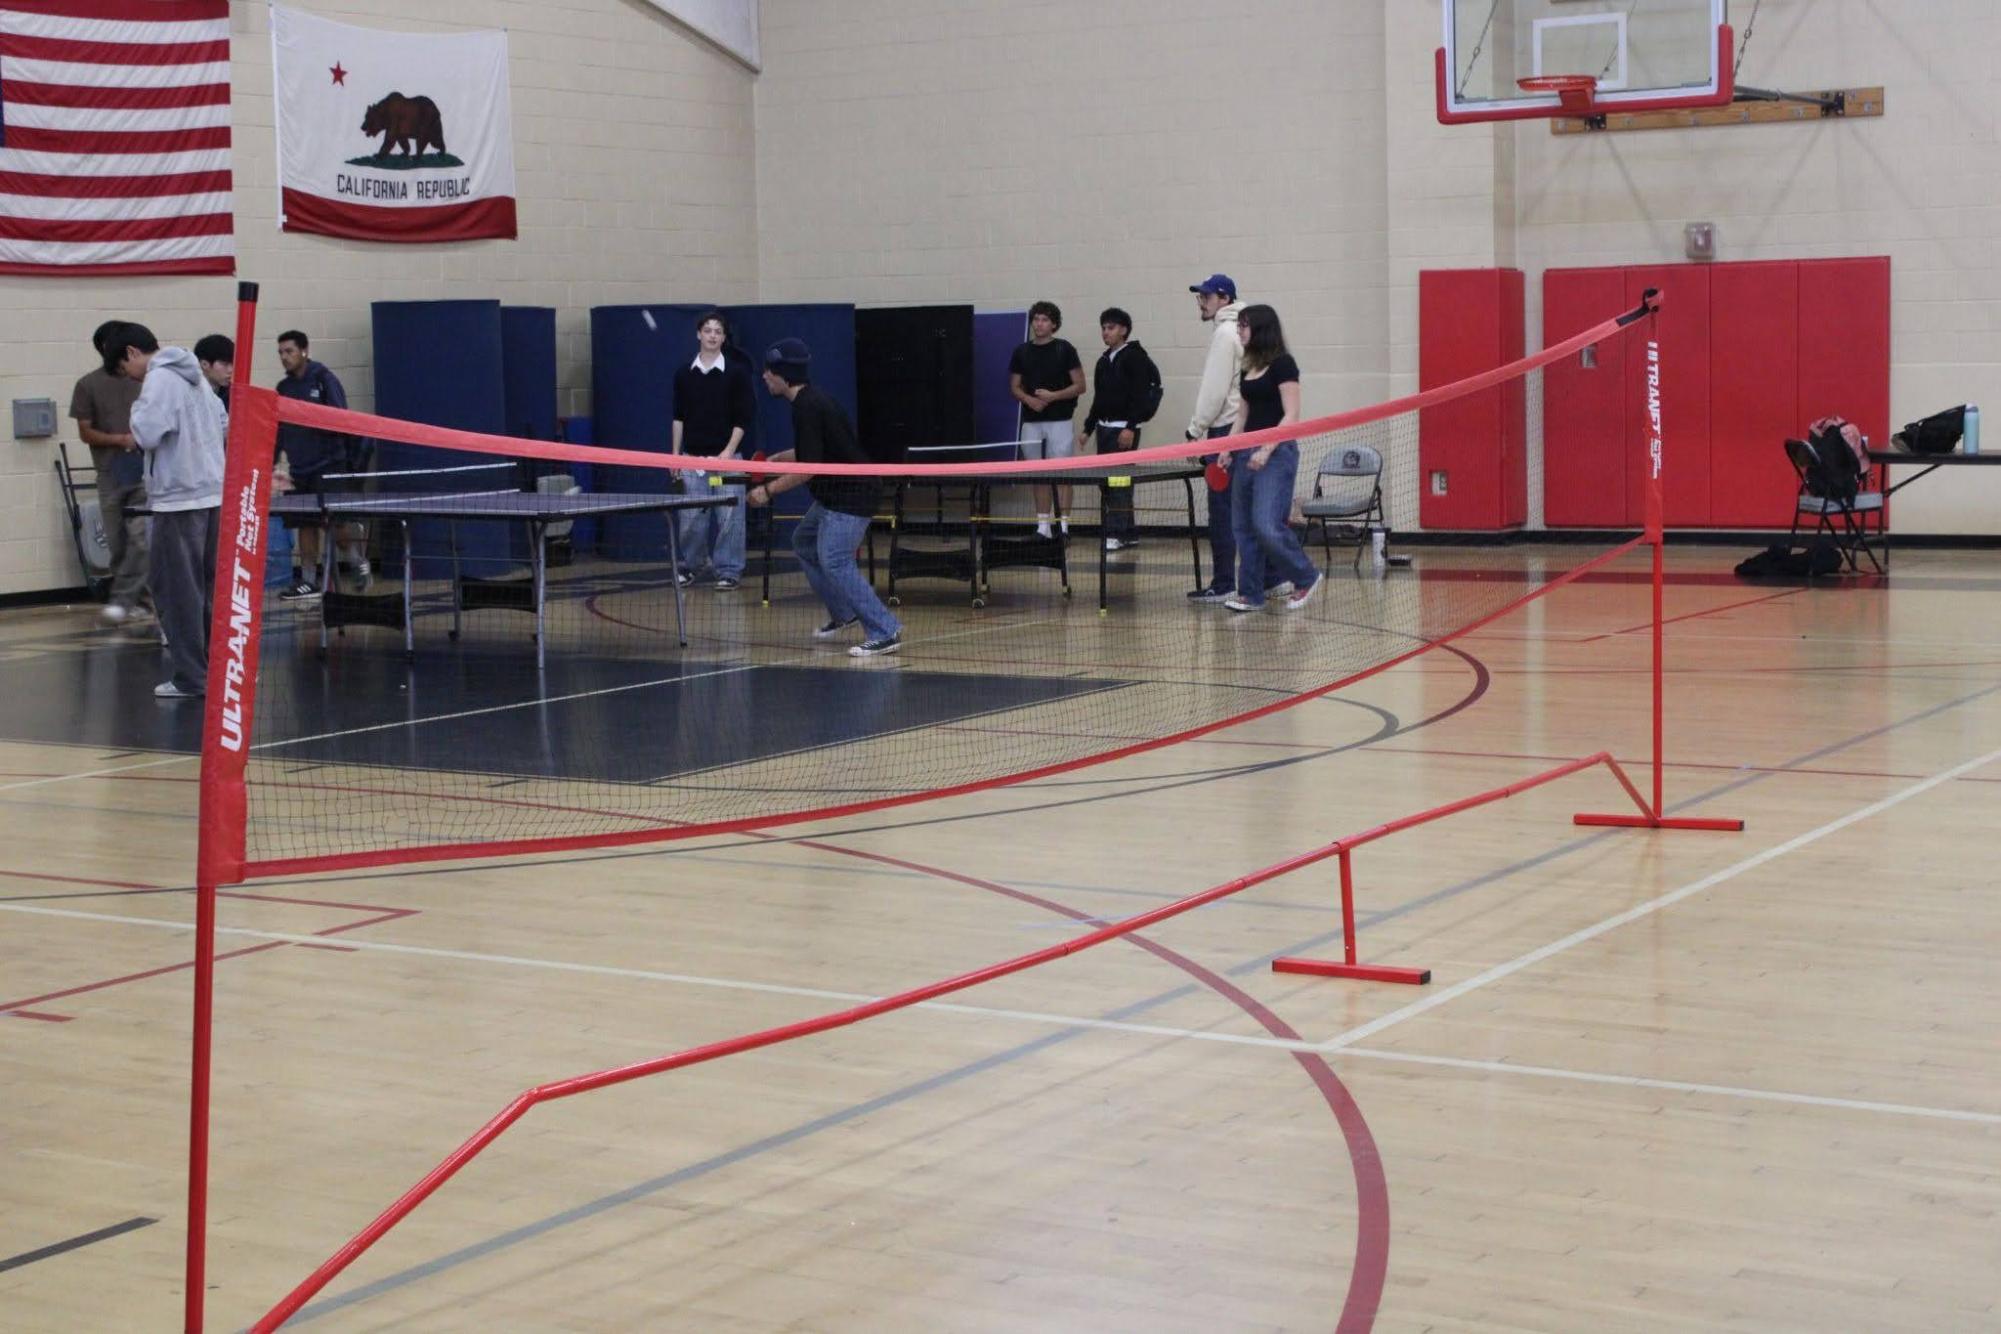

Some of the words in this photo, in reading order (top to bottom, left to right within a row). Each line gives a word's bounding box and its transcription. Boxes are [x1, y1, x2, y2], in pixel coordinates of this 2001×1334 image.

[337, 174, 408, 199] CALIFORNIA
[417, 176, 470, 199] REPUBLIC
[246, 468, 260, 523] System
[236, 486, 250, 547] Portable
[244, 525, 252, 553] Net
